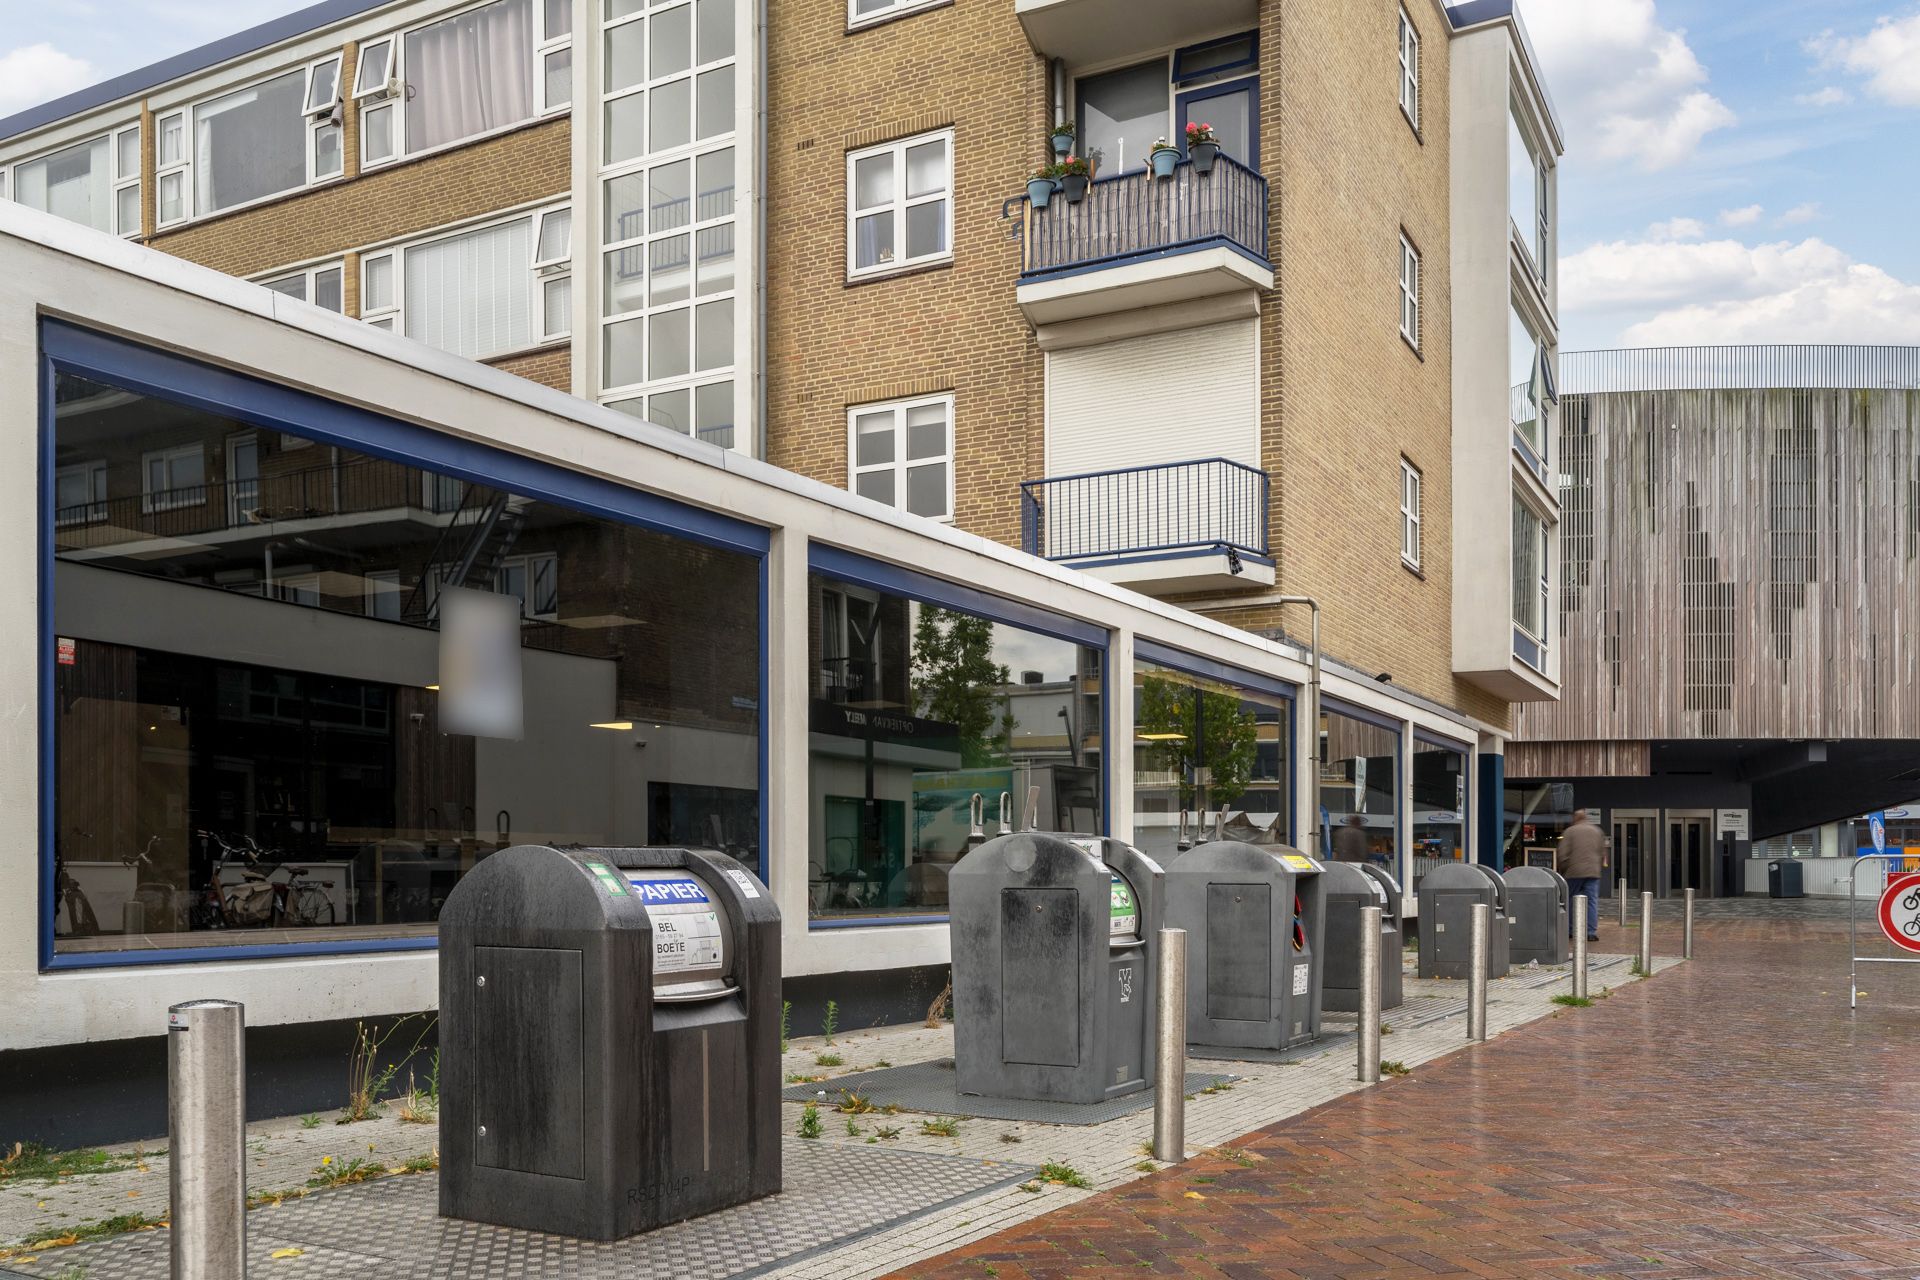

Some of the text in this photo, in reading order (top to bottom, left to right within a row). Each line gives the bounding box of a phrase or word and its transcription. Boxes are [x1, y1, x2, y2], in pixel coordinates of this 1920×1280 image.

[632, 883, 706, 900] PAPIER
[658, 922, 677, 933] BEL
[657, 942, 685, 954] BOETE
